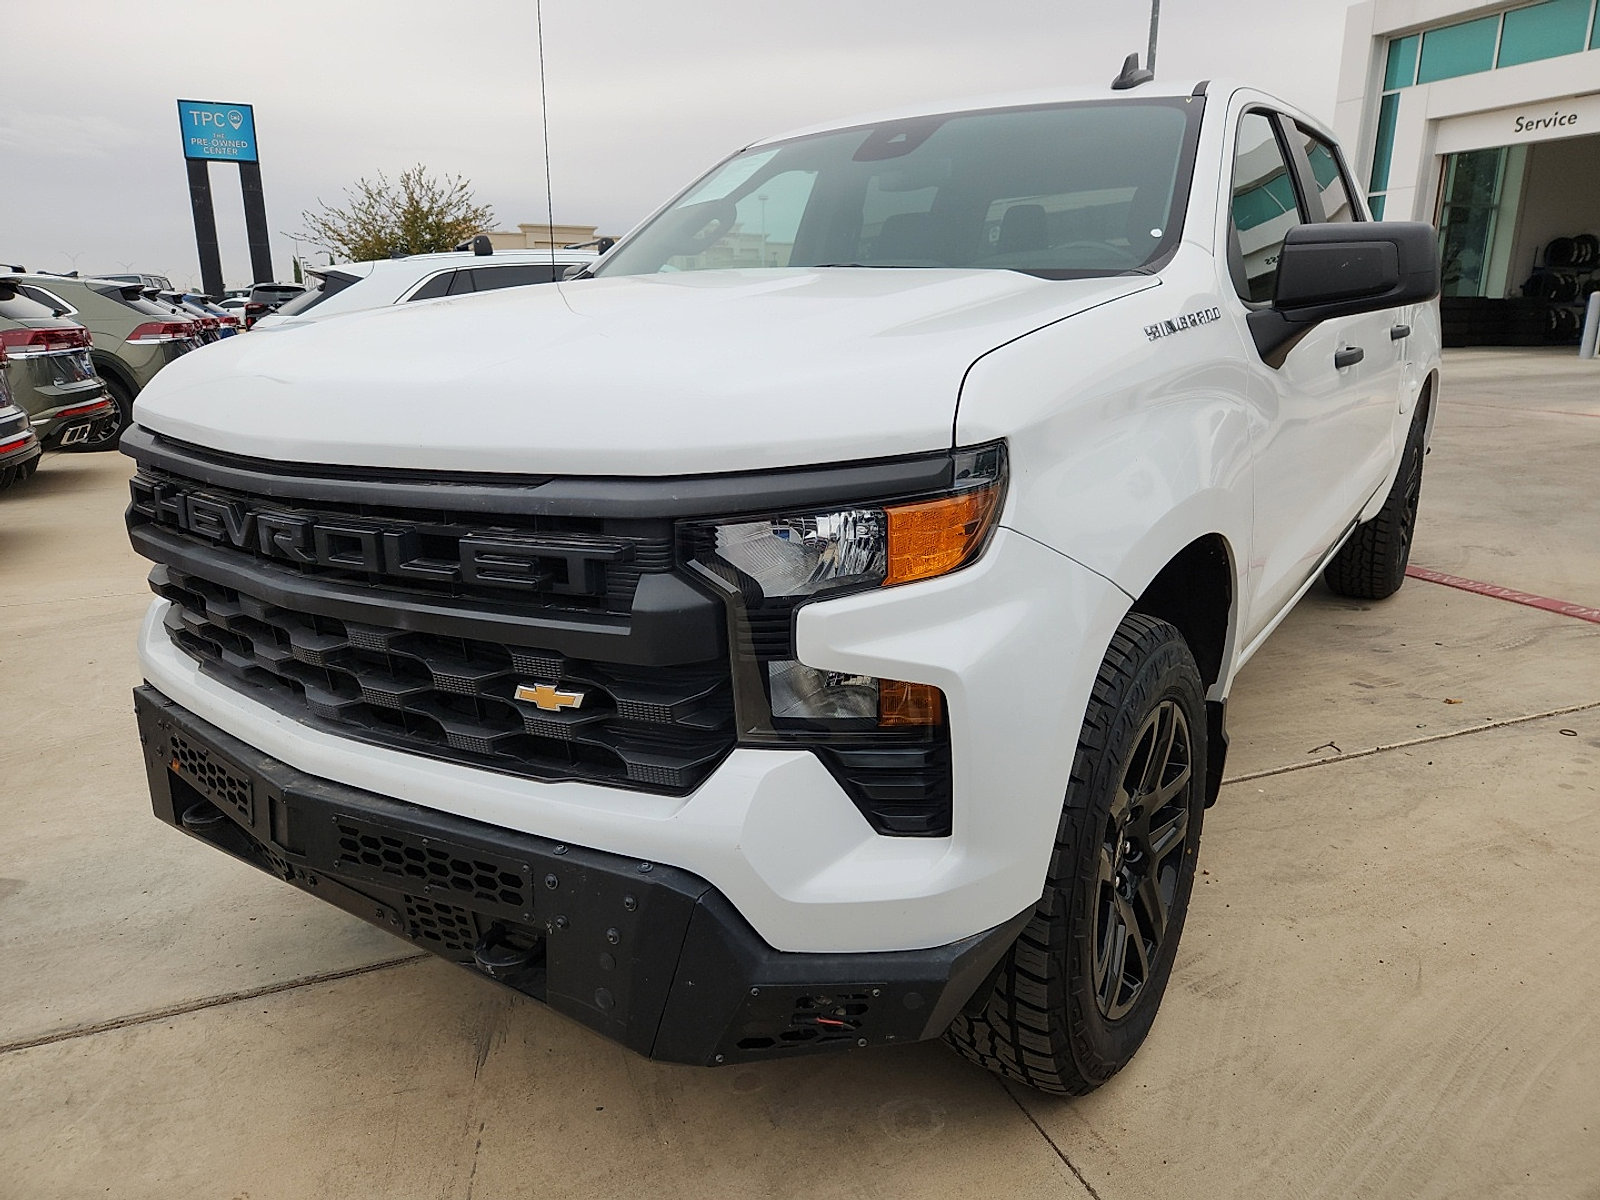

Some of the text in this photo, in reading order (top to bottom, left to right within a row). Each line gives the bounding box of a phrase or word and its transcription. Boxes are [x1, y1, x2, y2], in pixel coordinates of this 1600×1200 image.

[189, 110, 225, 127] TPC
[1515, 111, 1577, 133] Service
[191, 138, 248, 148] PRE-OWNED
[204, 147, 238, 155] CENTER
[129, 476, 636, 594] CHEVROLET
